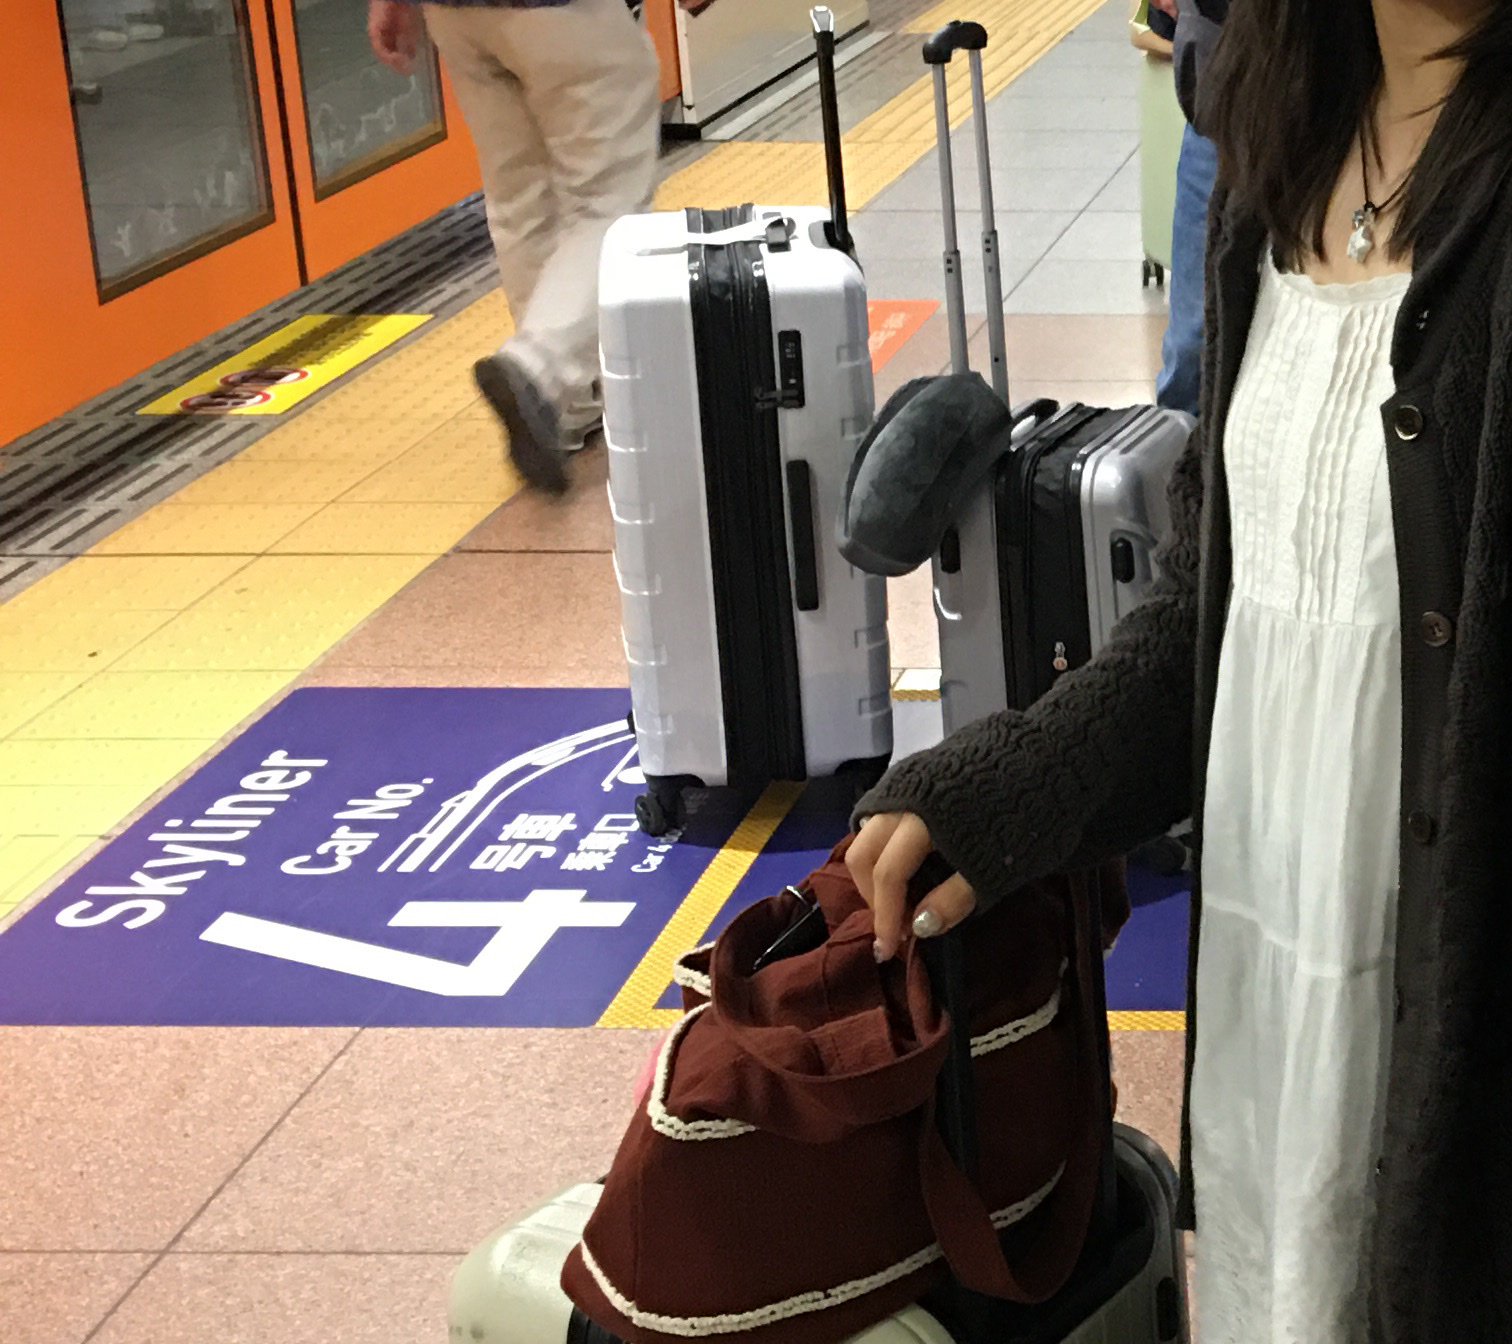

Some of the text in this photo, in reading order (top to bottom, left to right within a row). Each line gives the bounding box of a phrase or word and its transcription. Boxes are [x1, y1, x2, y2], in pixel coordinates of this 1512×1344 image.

[56, 750, 328, 930] Skyliner
[280, 777, 434, 875] Car No.
[630, 853, 665, 873] Car
[199, 813, 636, 996] 4 号車
